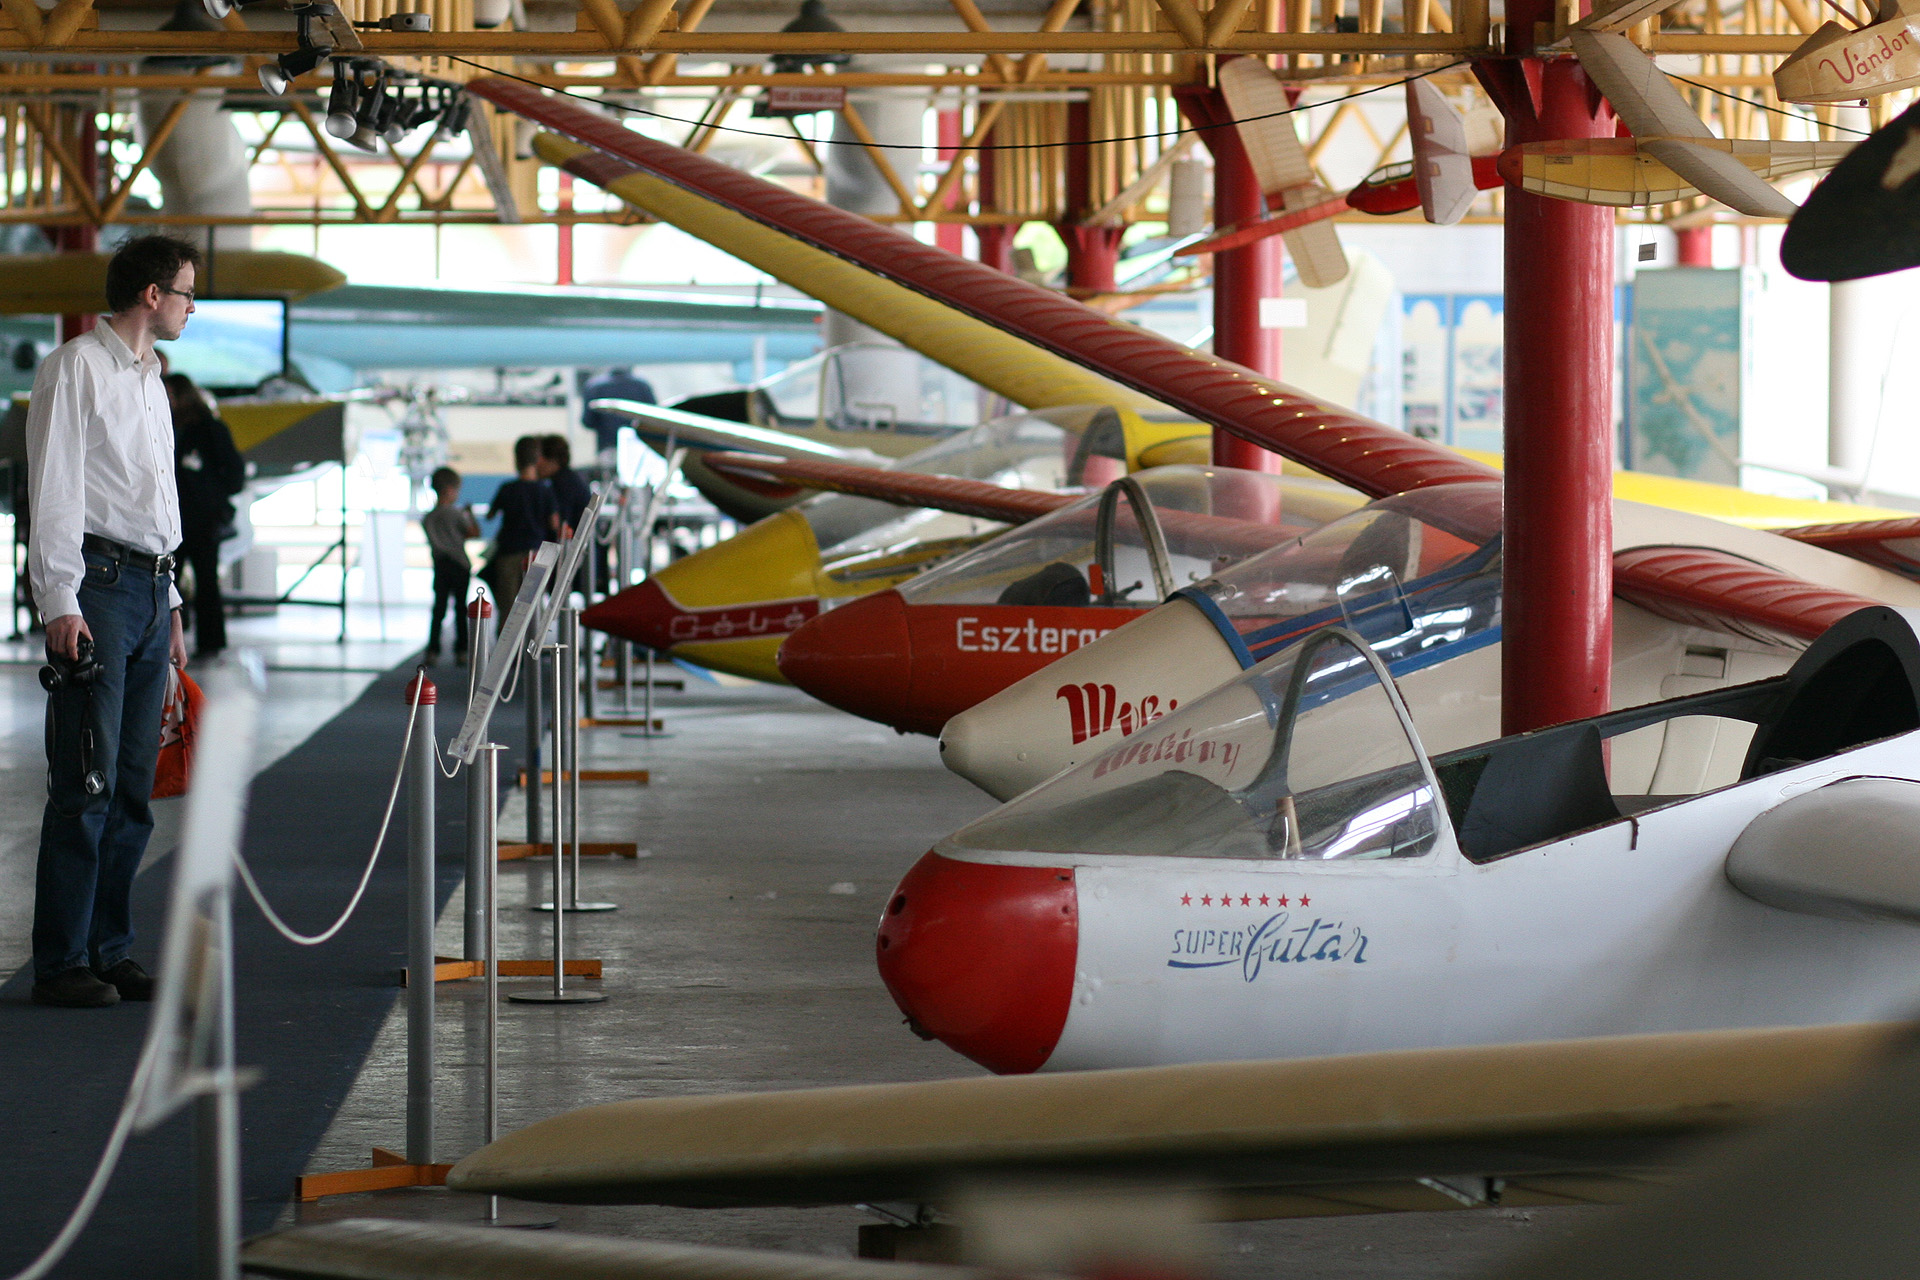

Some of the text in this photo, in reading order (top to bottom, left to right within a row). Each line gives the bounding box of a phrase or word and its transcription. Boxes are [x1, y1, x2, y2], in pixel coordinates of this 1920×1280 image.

[1818, 29, 1909, 84] Vándor
[956, 617, 1115, 653] Eszterg
[1171, 928, 1244, 956] SUPER
